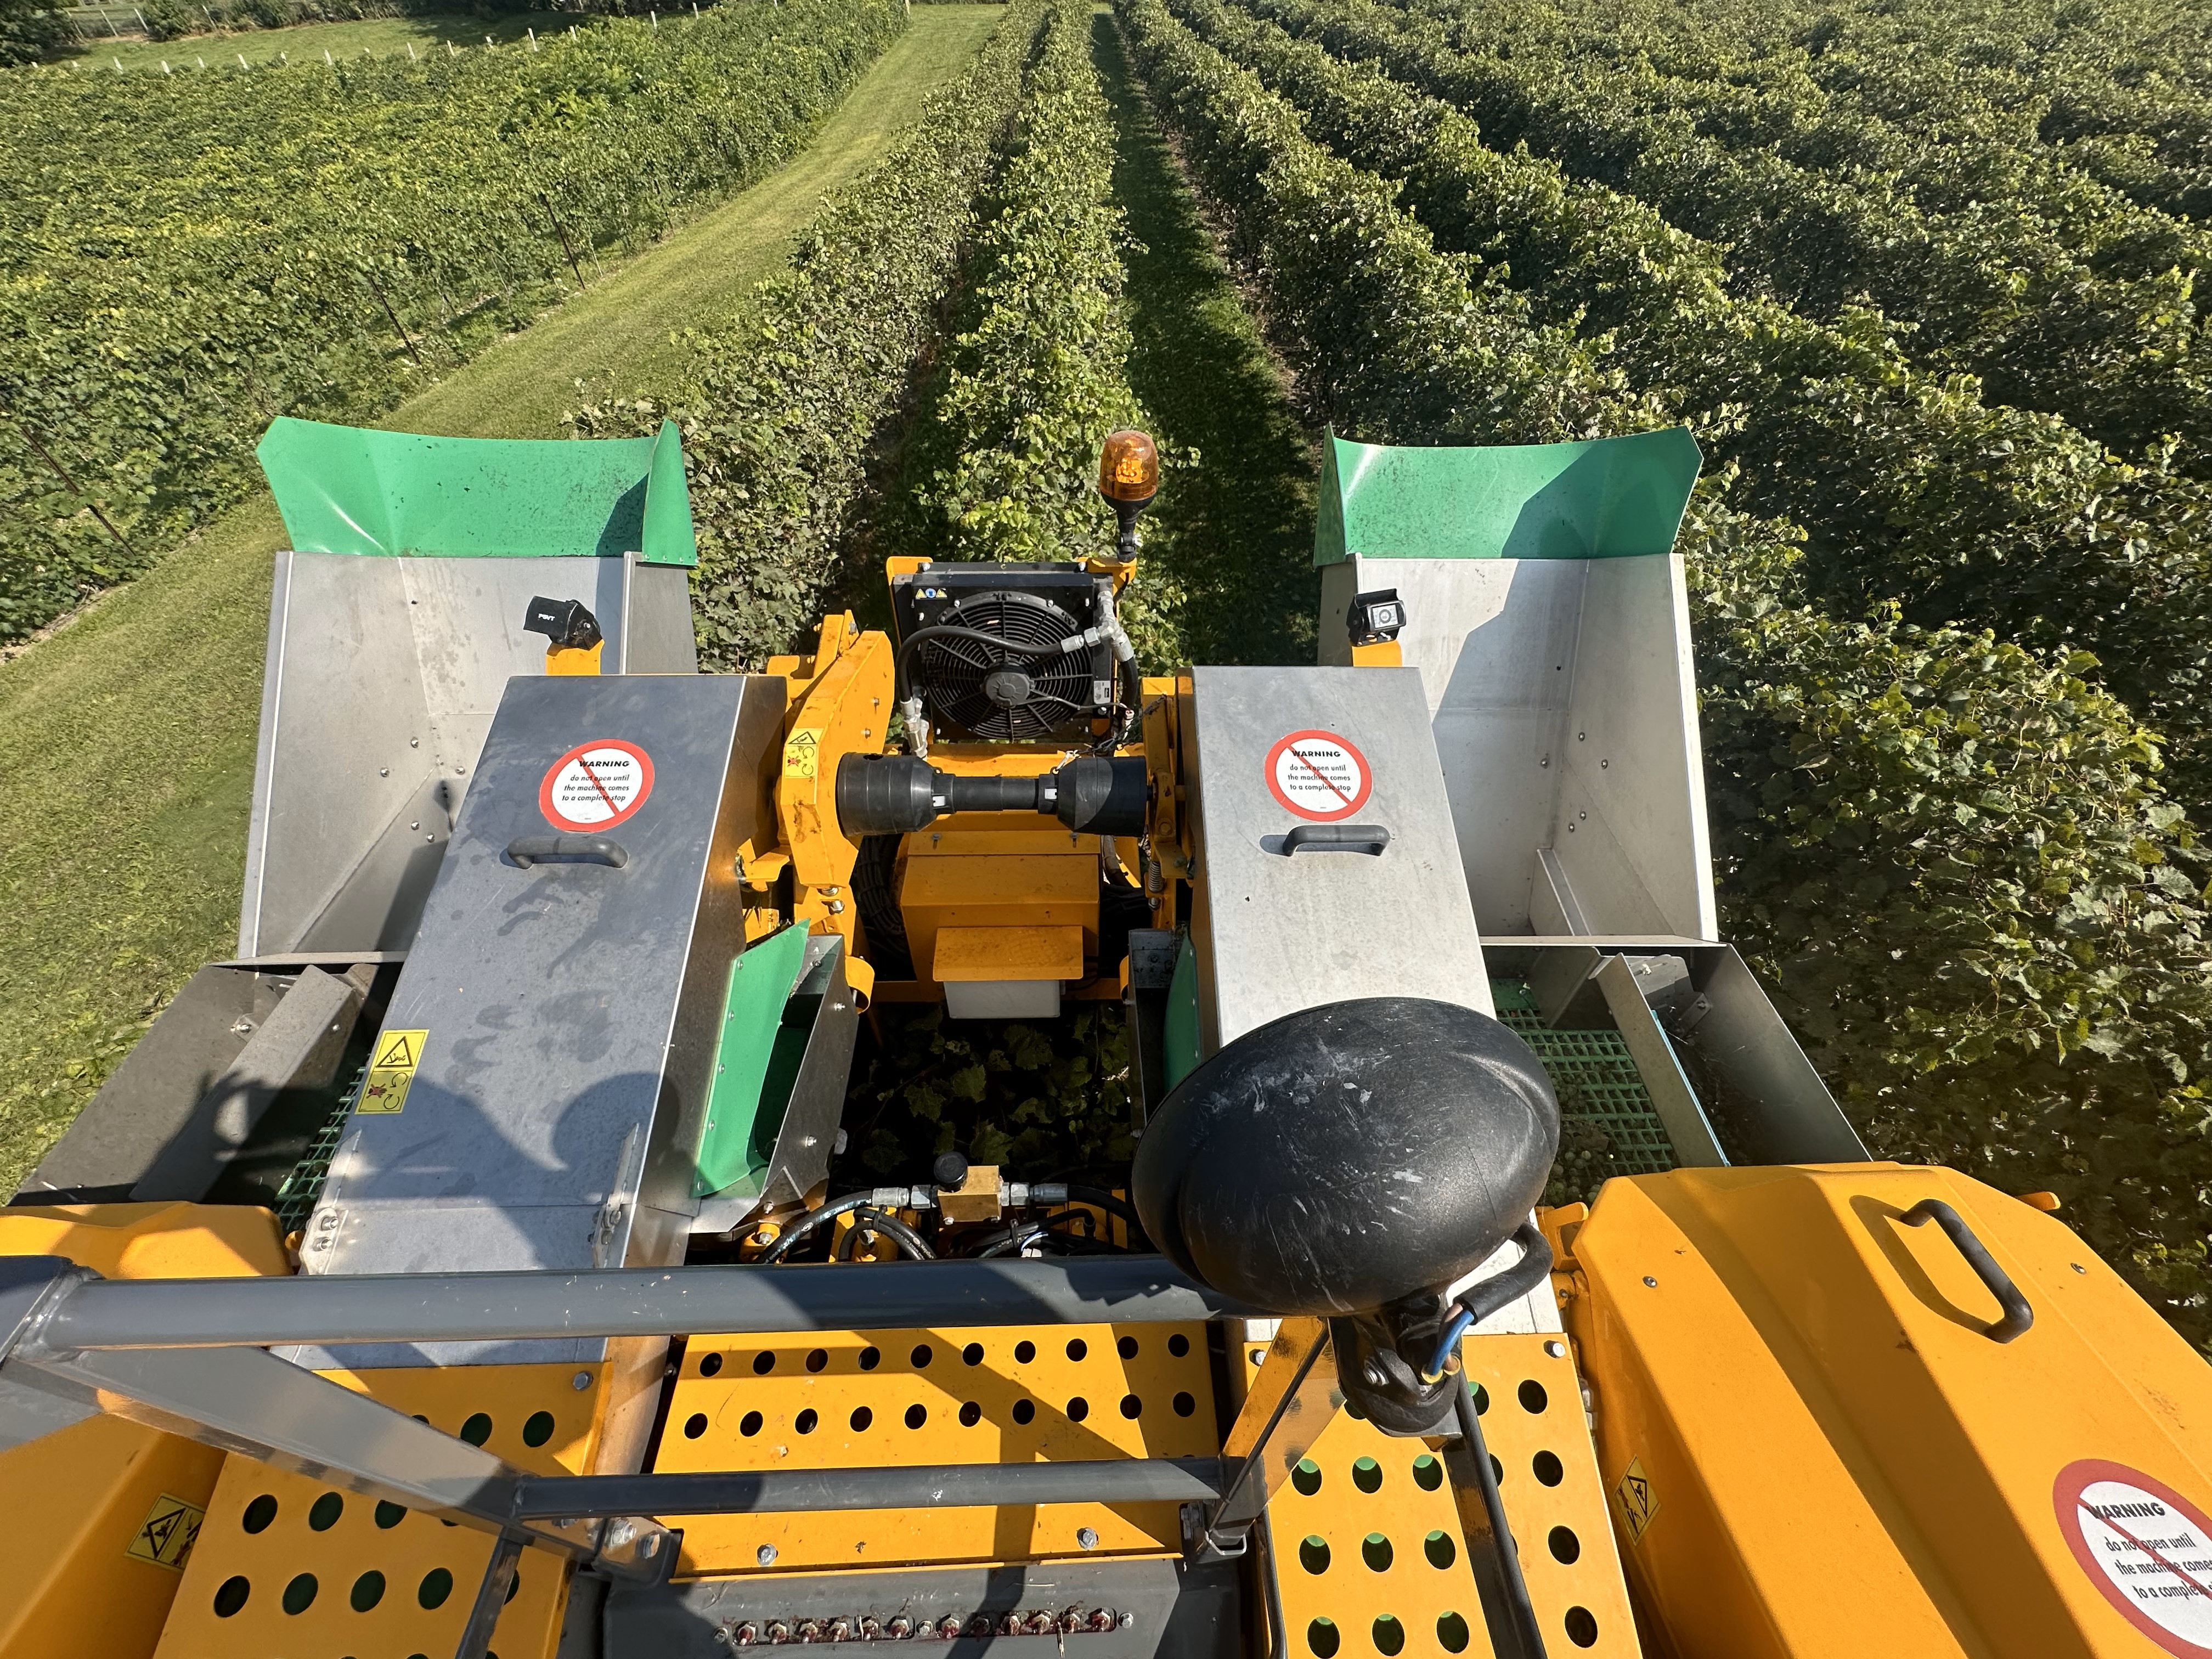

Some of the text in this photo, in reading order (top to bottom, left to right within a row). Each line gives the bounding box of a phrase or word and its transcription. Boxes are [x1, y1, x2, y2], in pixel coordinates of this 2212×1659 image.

[1305, 783, 1335, 792] complete
[577, 794, 610, 803] complete
[2085, 1502, 2166, 1519] WARNING
[2104, 1532, 2197, 1554] do not open until
[2114, 1559, 2137, 1575] the
[2132, 1585, 2148, 1599] to
[2148, 1587, 2159, 1598] a
